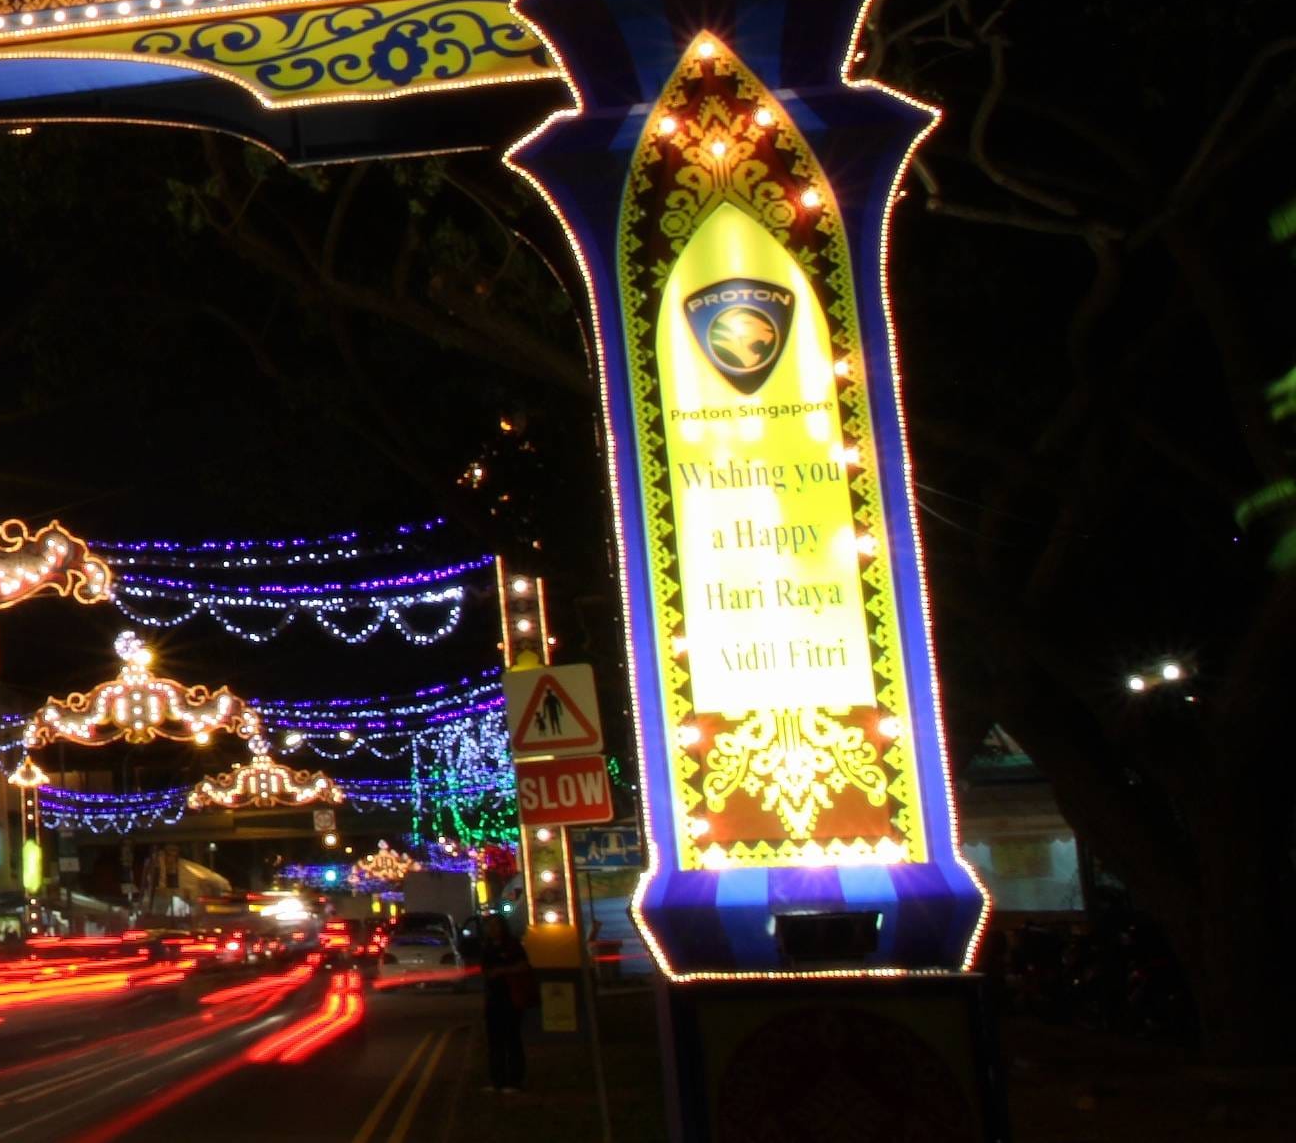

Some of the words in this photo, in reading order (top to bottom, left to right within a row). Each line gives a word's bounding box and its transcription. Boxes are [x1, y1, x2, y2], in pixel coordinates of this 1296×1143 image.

[686, 287, 793, 314] PROTON
[670, 407, 733, 423] Proton
[738, 400, 834, 420] Singapore
[678, 457, 786, 493] Wishing
[795, 462, 842, 494] you
[712, 533, 726, 551] a
[735, 519, 821, 555] Happy
[705, 579, 764, 612] Hari
[776, 578, 843, 616] Raya
[789, 637, 848, 672] Fitri
[520, 771, 604, 810] SLOW
